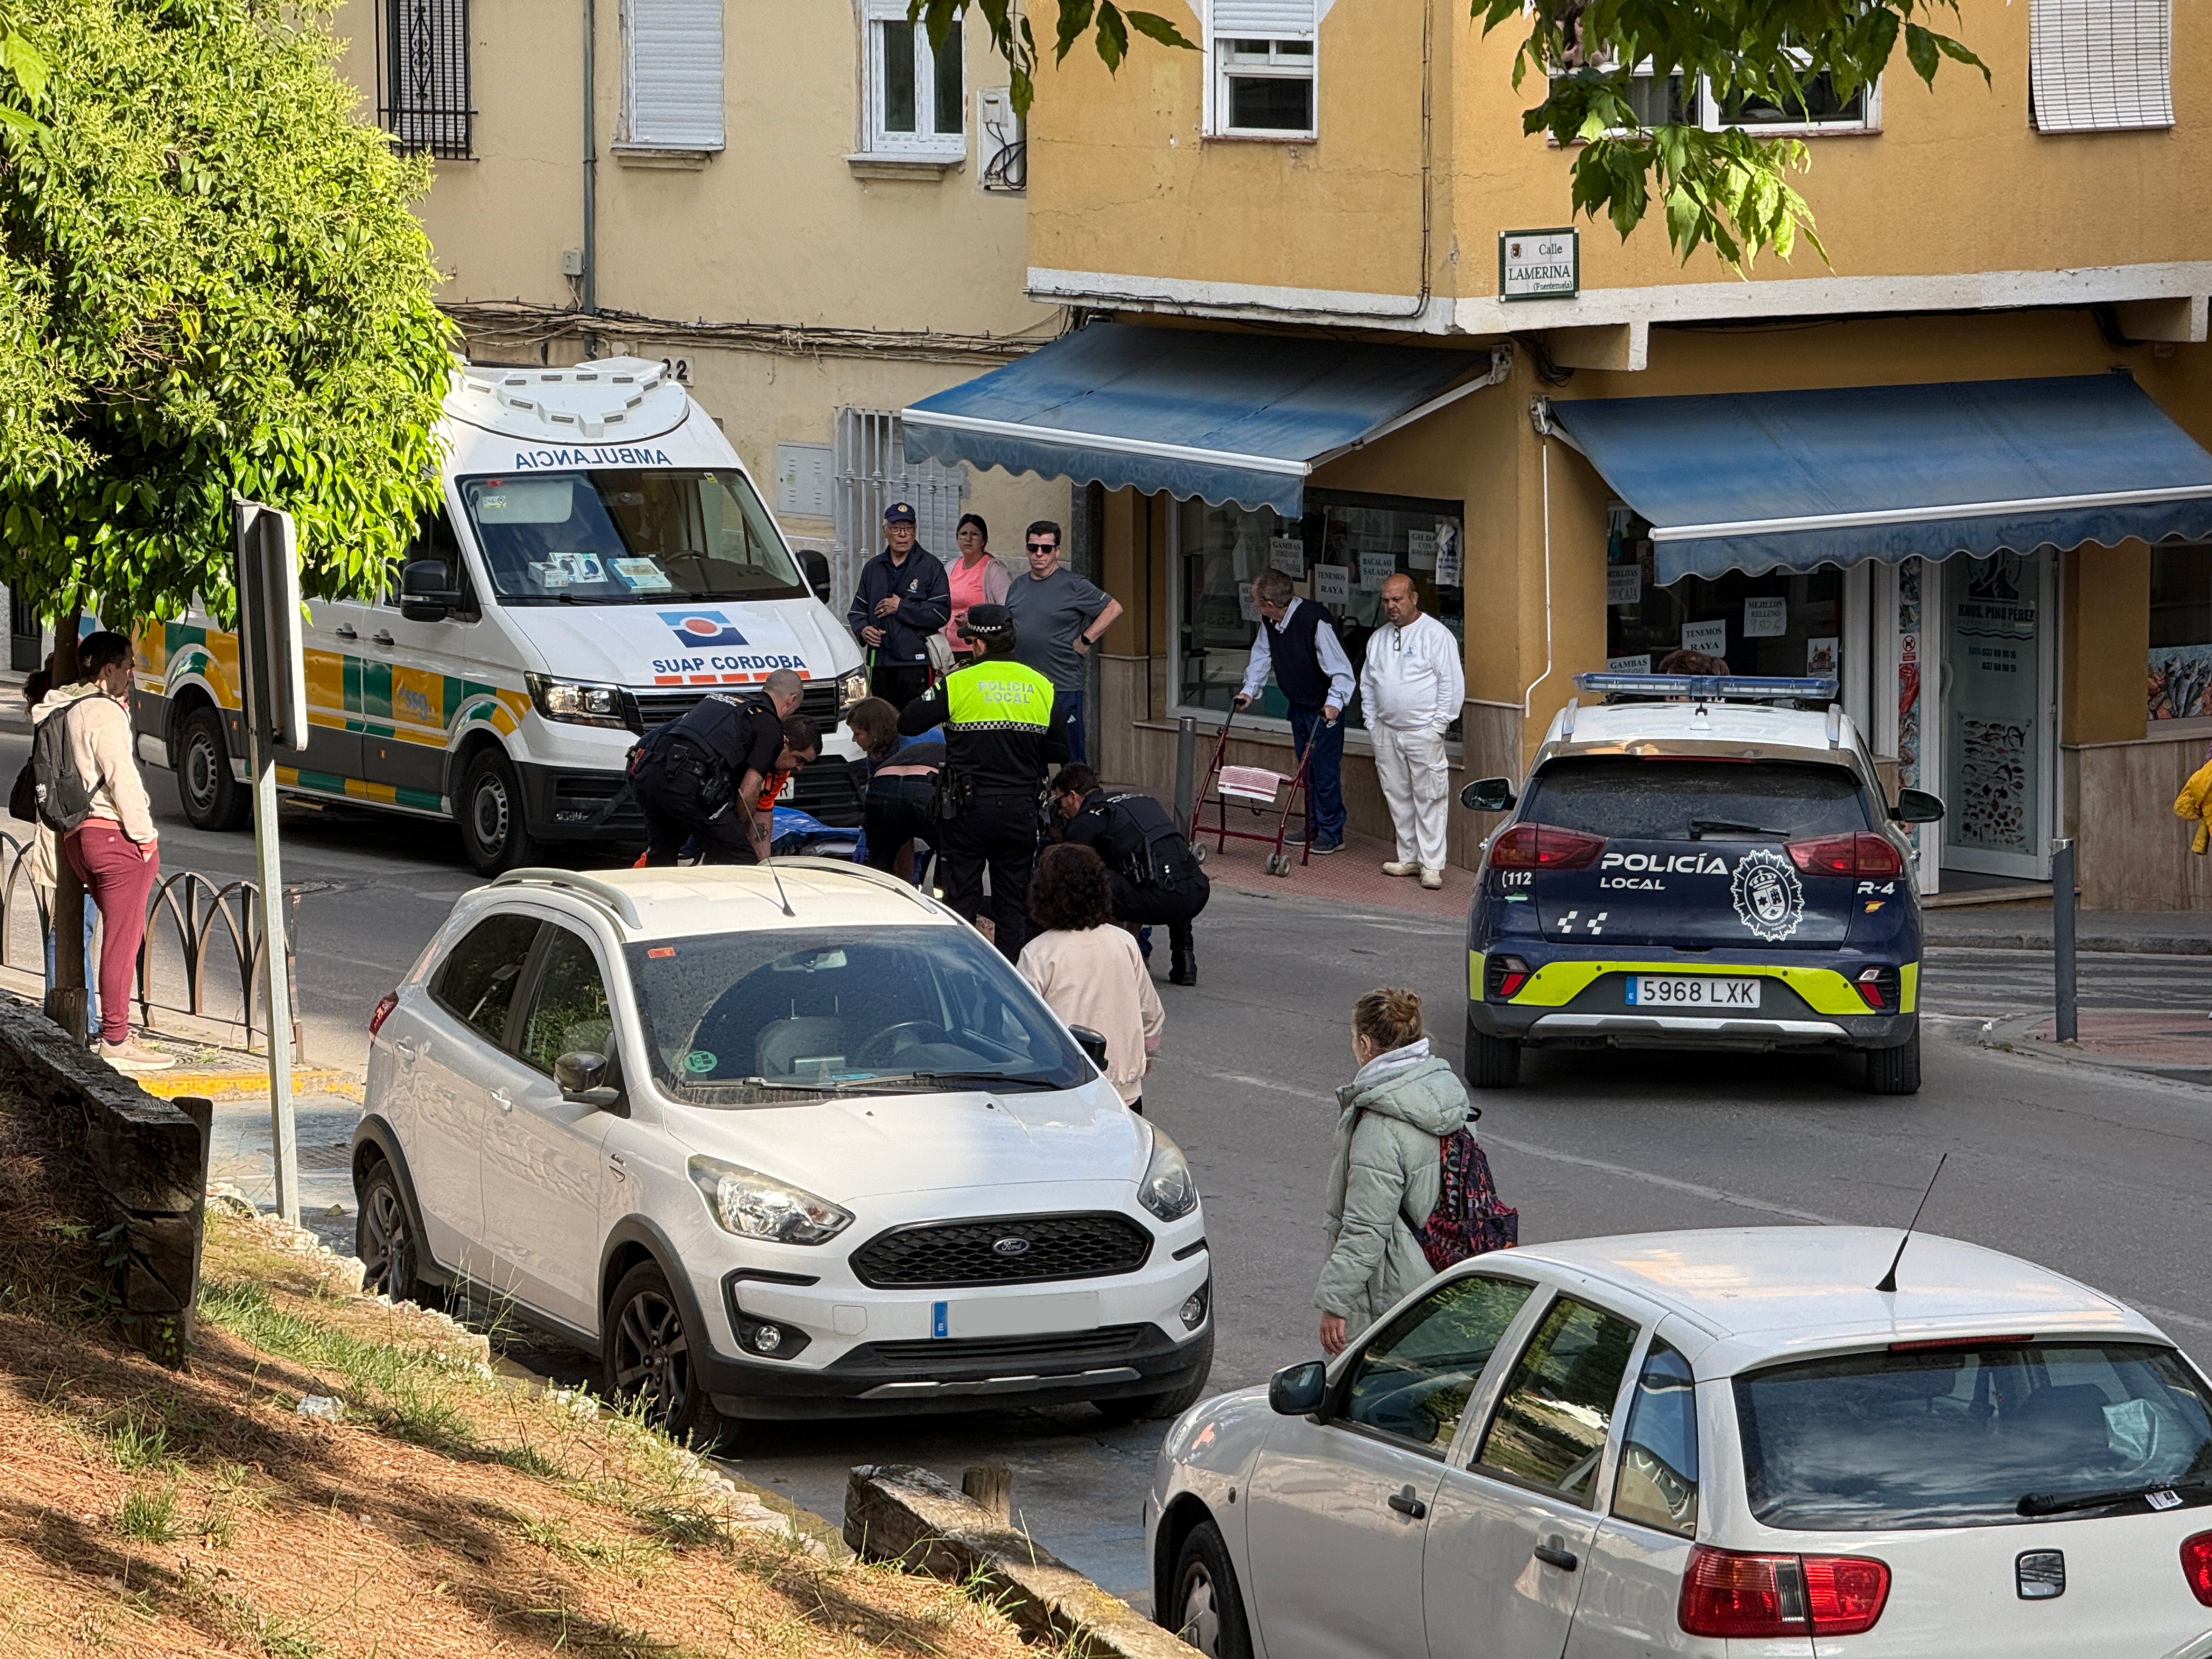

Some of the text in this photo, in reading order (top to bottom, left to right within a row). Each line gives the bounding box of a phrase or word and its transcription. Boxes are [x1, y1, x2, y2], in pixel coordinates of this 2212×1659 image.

[1539, 244, 1562, 255] Calle
[1508, 265, 1571, 281] LAMERINA
[1273, 541, 1301, 551] GAMBAS
[1363, 558, 1392, 567] BACALAO
[1317, 572, 1346, 580] TENEMOS
[1363, 568, 1392, 576] SALADO
[1321, 585, 1344, 594] RAYA
[1686, 628, 1722, 637] TENEMOS
[1691, 641, 1719, 651] RAYA
[652, 655, 807, 673] SUAP CORDOBA
[1610, 659, 1647, 669] GAMBAS
[978, 681, 1035, 694] POLICIA
[985, 692, 1030, 704] LOCAL
[1601, 853, 1729, 875] POLICÍA
[1600, 877, 1666, 890] LOCAL
[1857, 881, 1895, 895] R-4
[1644, 981, 1702, 1002] 5968
[1711, 982, 1754, 1003] LXK
[1001, 1241, 1022, 1251] Ford
[938, 1323, 944, 1331] E
